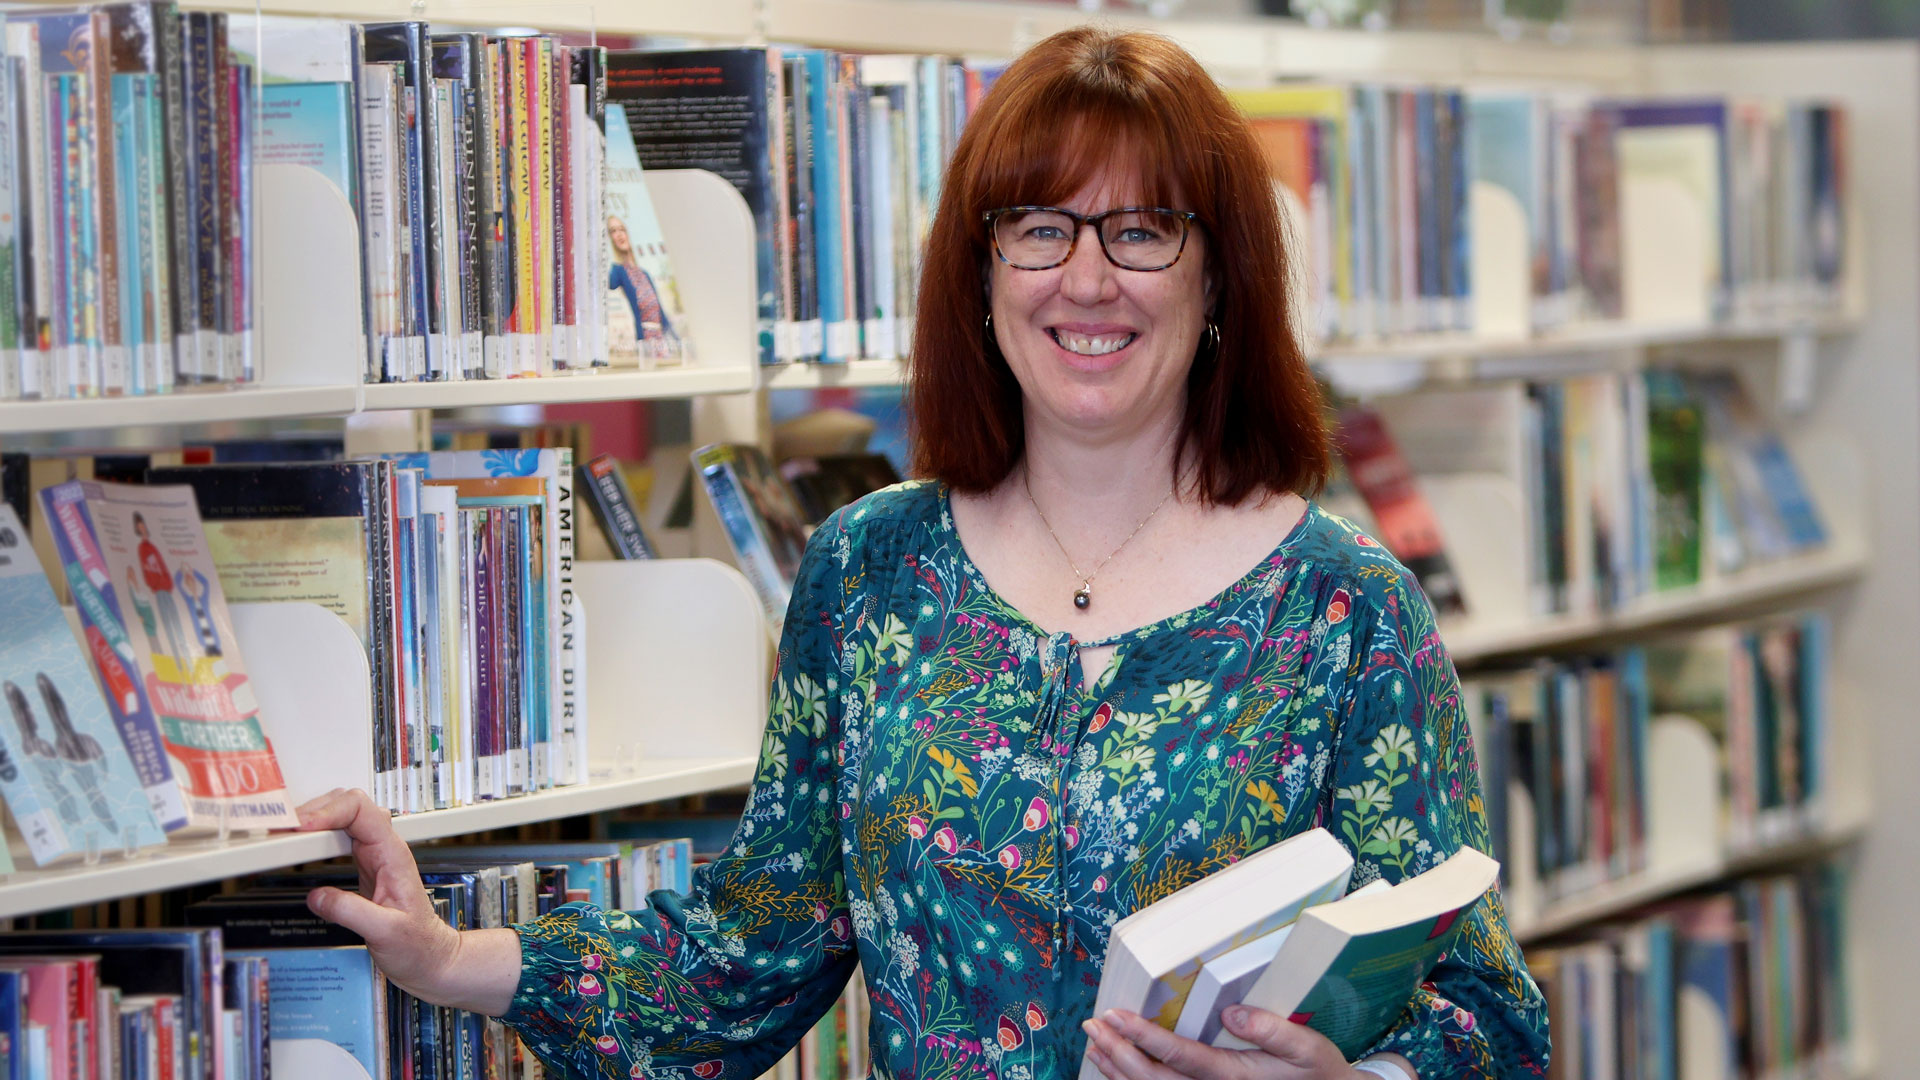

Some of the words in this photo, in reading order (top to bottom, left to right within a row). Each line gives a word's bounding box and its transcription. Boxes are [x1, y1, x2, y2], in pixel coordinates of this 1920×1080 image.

[195, 43, 211, 154] DEVIL'S
[553, 59, 561, 112] JENNY
[520, 119, 530, 196] COLGAN
[542, 115, 550, 191] COLGAN
[554, 115, 563, 185] COLGAN
[199, 160, 214, 251] SLAVE
[465, 129, 479, 265] BINDING
[598, 474, 622, 504] EEP
[611, 502, 636, 532] HER
[58, 503, 92, 560] Without
[76, 580, 120, 642] FURTHER
[380, 480, 392, 618] CORNWELL
[559, 485, 573, 651] AMERICAN
[477, 569, 487, 618] Dilly
[479, 625, 489, 687] Court
[155, 684, 223, 718] Without
[179, 721, 253, 749] FURTHER
[562, 668, 575, 739] DIRT
[138, 728, 165, 783] JESSICA
